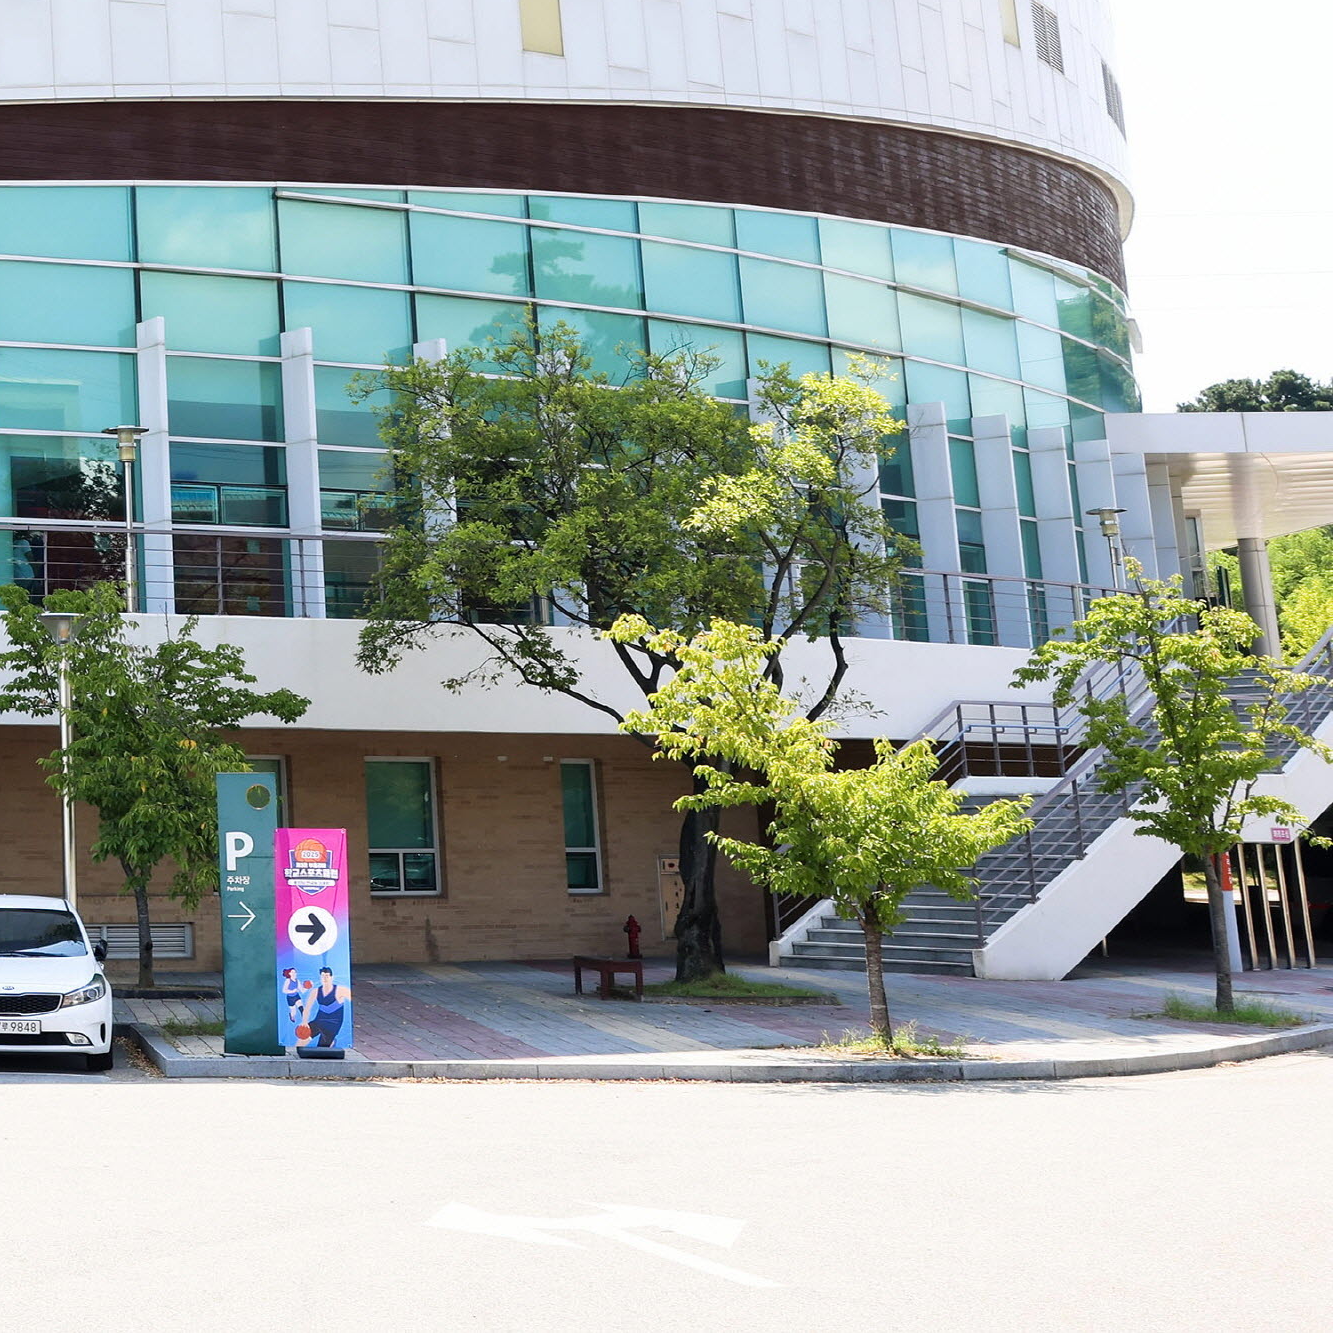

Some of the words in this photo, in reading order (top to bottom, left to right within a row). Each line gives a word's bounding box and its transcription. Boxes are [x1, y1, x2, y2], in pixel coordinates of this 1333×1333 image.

[225, 831, 254, 871] P
[226, 875, 250, 885] 주차장
[10, 1022, 37, 1032] 9848
